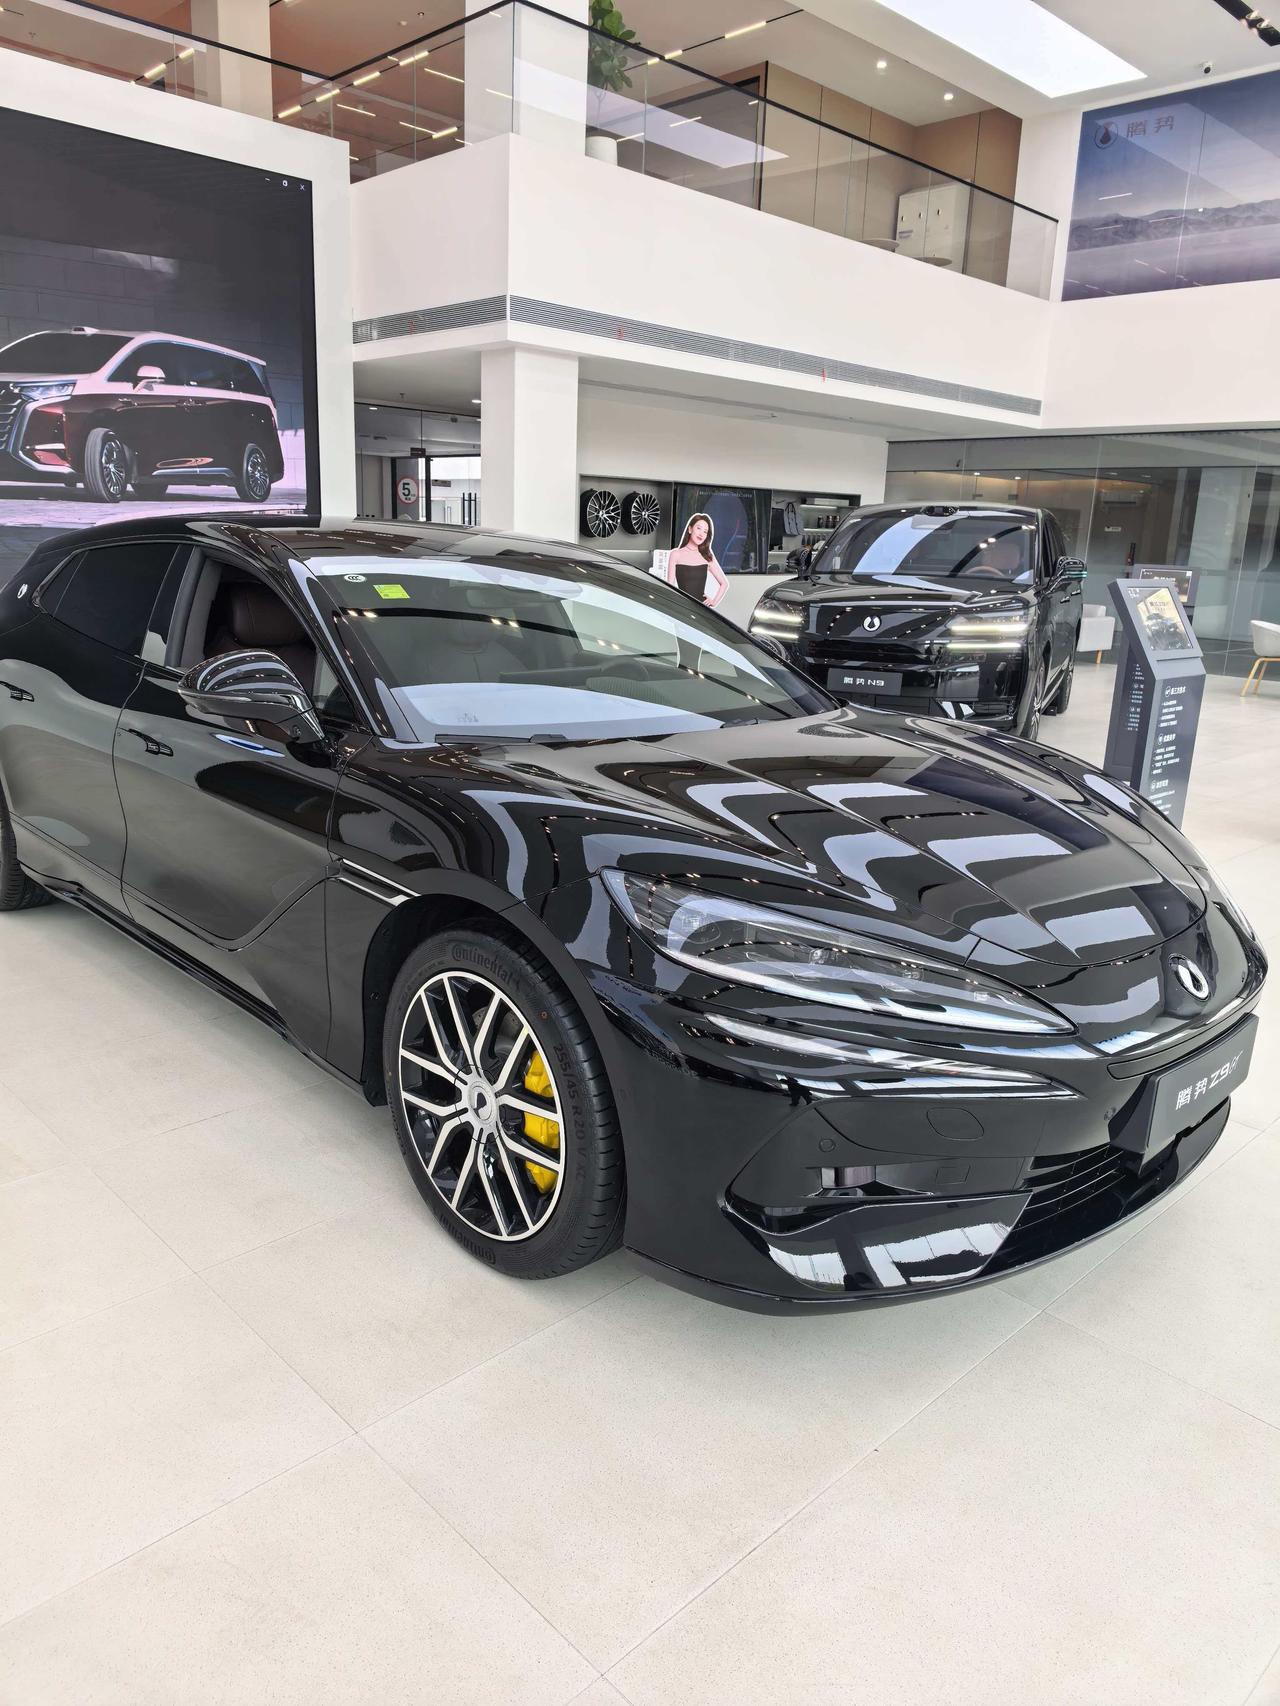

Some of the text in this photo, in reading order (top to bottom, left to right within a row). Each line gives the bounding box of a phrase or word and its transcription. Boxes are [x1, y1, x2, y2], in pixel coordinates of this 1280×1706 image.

[402, 482, 410, 496] 5
[867, 679, 885, 687] N9
[451, 943, 514, 985] Continental
[553, 1043, 580, 1099] 255/45
[1175, 1077, 1208, 1110] 腾势
